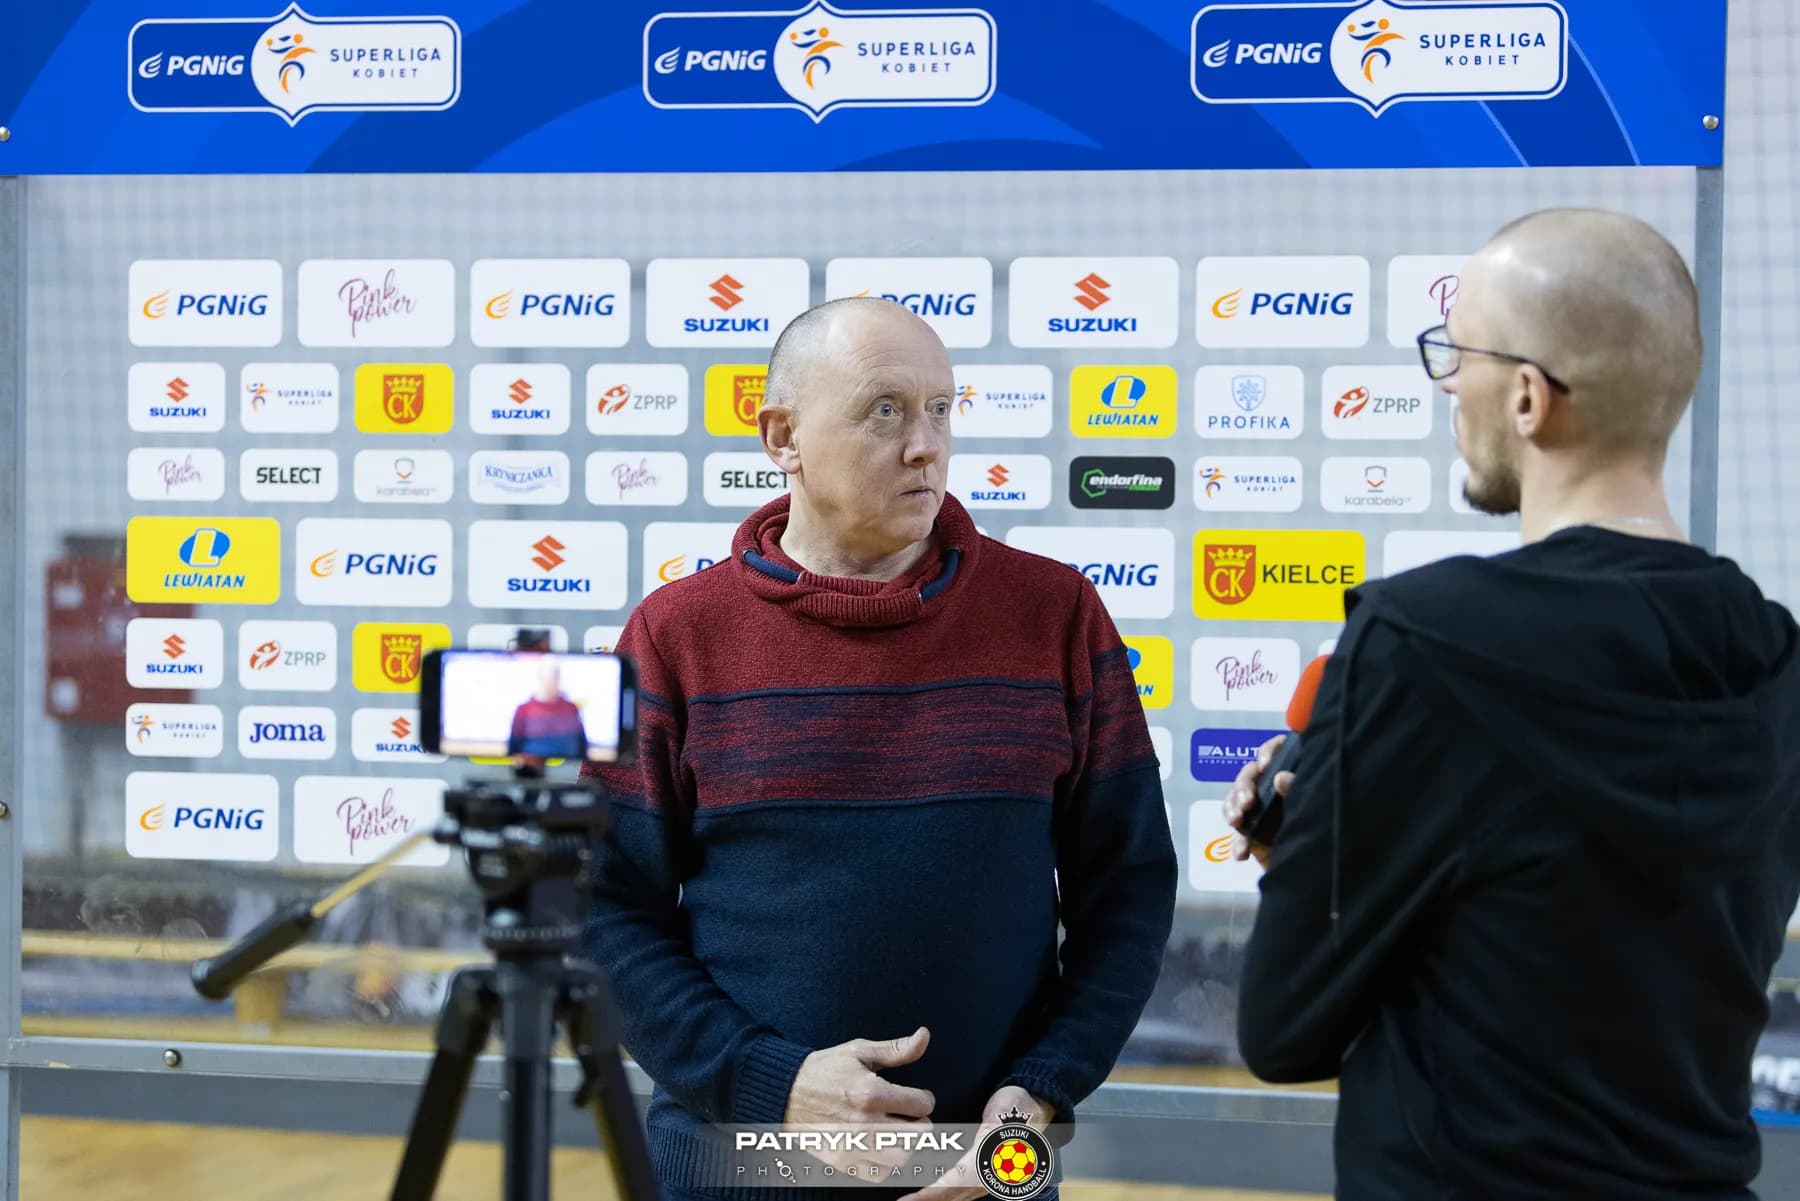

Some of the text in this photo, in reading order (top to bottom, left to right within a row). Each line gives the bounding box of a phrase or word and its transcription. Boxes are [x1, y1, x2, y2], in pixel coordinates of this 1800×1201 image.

[858, 41, 976, 57] SUPERLIGA
[1420, 33, 1546, 49] SUPERLIGA
[330, 48, 441, 62] SUPERLIGA
[685, 49, 767, 72] PGNiG
[1235, 42, 1323, 65] PGNiG
[1445, 55, 1521, 66] KOBIET
[167, 55, 244, 76] PGNiG
[353, 68, 419, 78] KOBIET
[882, 63, 951, 73] KOBIET
[338, 268, 398, 317] Pink
[177, 295, 268, 316] PGNiG
[521, 294, 616, 316] PGNiG
[1250, 292, 1353, 315] PGNiG
[348, 295, 415, 338] power
[684, 318, 769, 332] SUZUKI
[1048, 318, 1137, 332] SUZUKI
[277, 389, 333, 398] SUPERLIGA
[986, 393, 1046, 402] SUPERLIGA
[387, 393, 416, 419] CK
[633, 395, 677, 410] ZPRP
[1373, 398, 1421, 414] ZPRP
[149, 407, 207, 417] SUZUKI
[491, 409, 551, 420] SUZUKI
[1087, 413, 1159, 426] LEWIATAN
[1208, 415, 1290, 430] PROFIKA
[256, 466, 322, 484] SELECT
[485, 465, 553, 484] KRYNICZANKA
[721, 471, 788, 488] SELECT
[1089, 474, 1163, 486] endorfina
[1234, 475, 1296, 485] SUPERLIGA
[971, 491, 1026, 501] SUZUKI
[345, 553, 438, 576] PGNiG
[164, 574, 246, 589] LEWIATAN
[1262, 564, 1355, 585] KIELCE
[507, 578, 590, 592] SUZUKI
[284, 651, 326, 667] ZPRP
[384, 653, 415, 679] CK
[146, 664, 203, 674] SUZUKI
[1216, 650, 1262, 685] Pink
[1225, 670, 1278, 701] power
[162, 722, 217, 731] SUPERLIGA
[376, 743, 424, 753] SUZUK
[1211, 746, 1259, 757] ALUT
[173, 807, 264, 830] PGNiG
[337, 788, 395, 834] Pink
[348, 814, 414, 856] power
